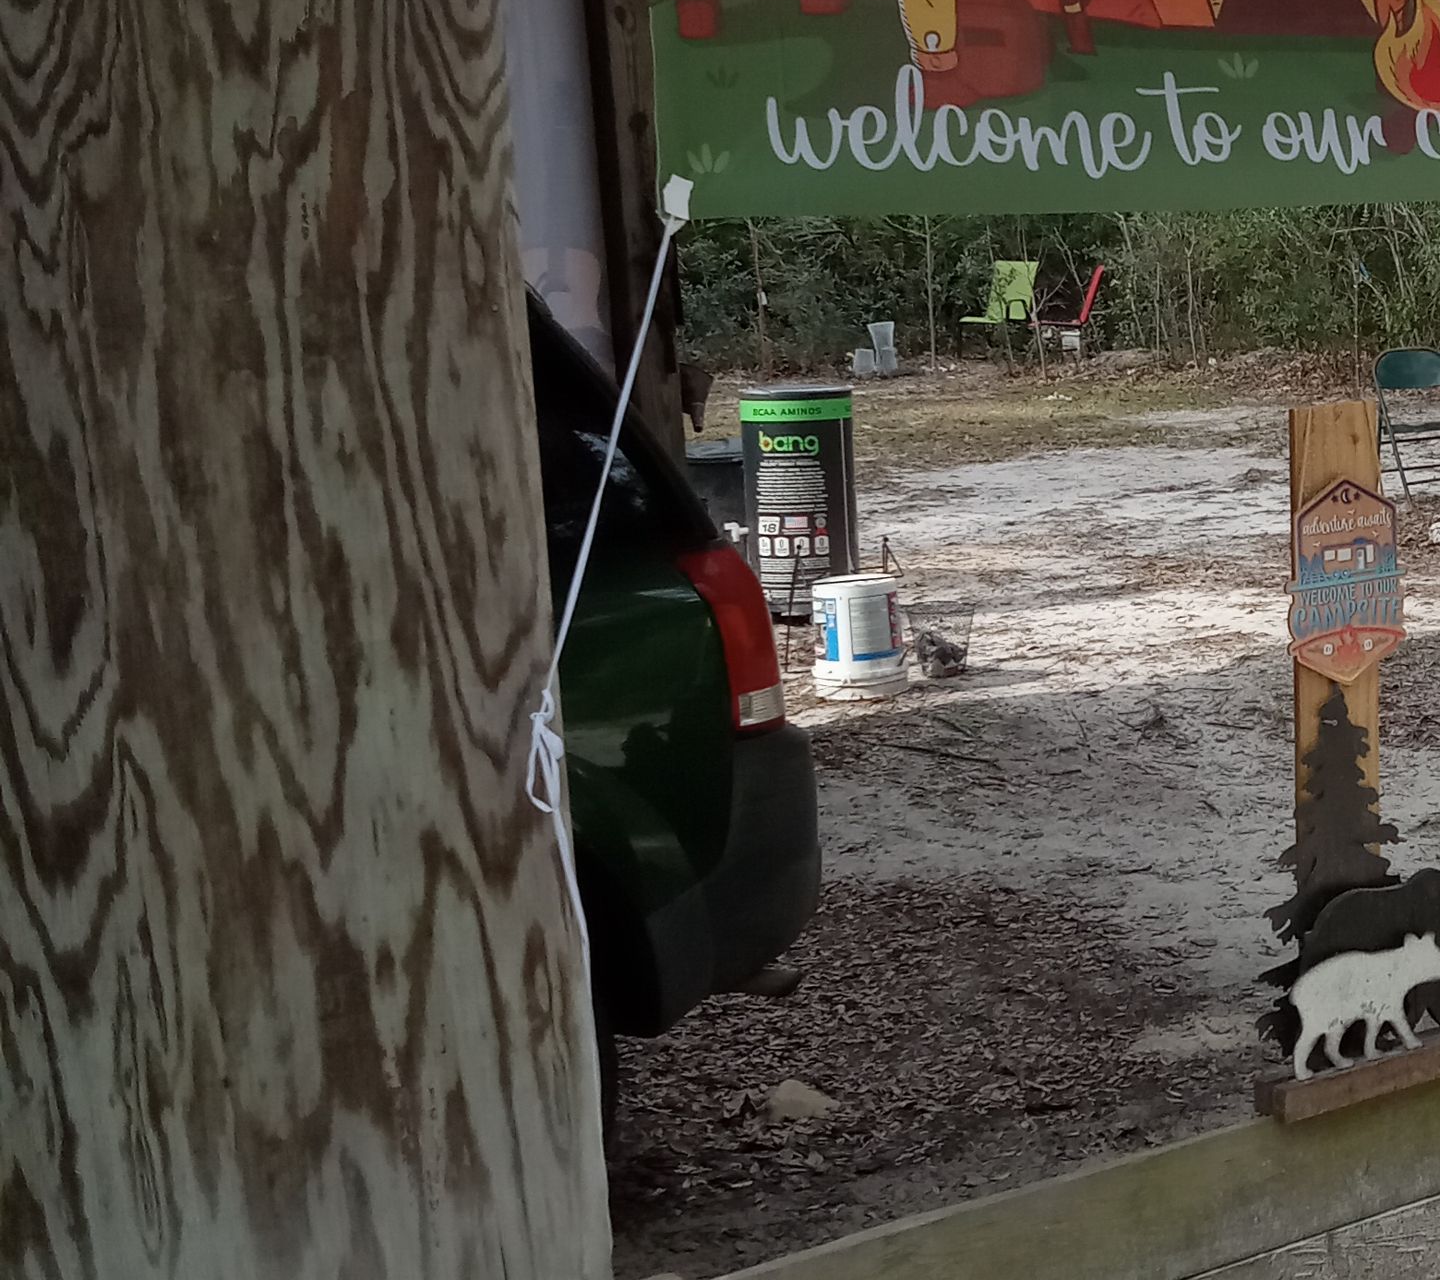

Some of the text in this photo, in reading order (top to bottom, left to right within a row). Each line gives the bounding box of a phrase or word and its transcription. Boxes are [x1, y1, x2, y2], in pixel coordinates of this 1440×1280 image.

[764, 63, 1158, 180] welcome
[1134, 70, 1237, 167] to
[1261, 105, 1397, 171] our
[753, 407, 822, 416] BCAA AMINOS
[758, 430, 820, 456] bang
[762, 523, 777, 533] 18
[1303, 507, 1392, 535] adventure awaits
[1302, 577, 1398, 606] WELCOME TO OUR
[1294, 596, 1400, 639] CAMPSITE
